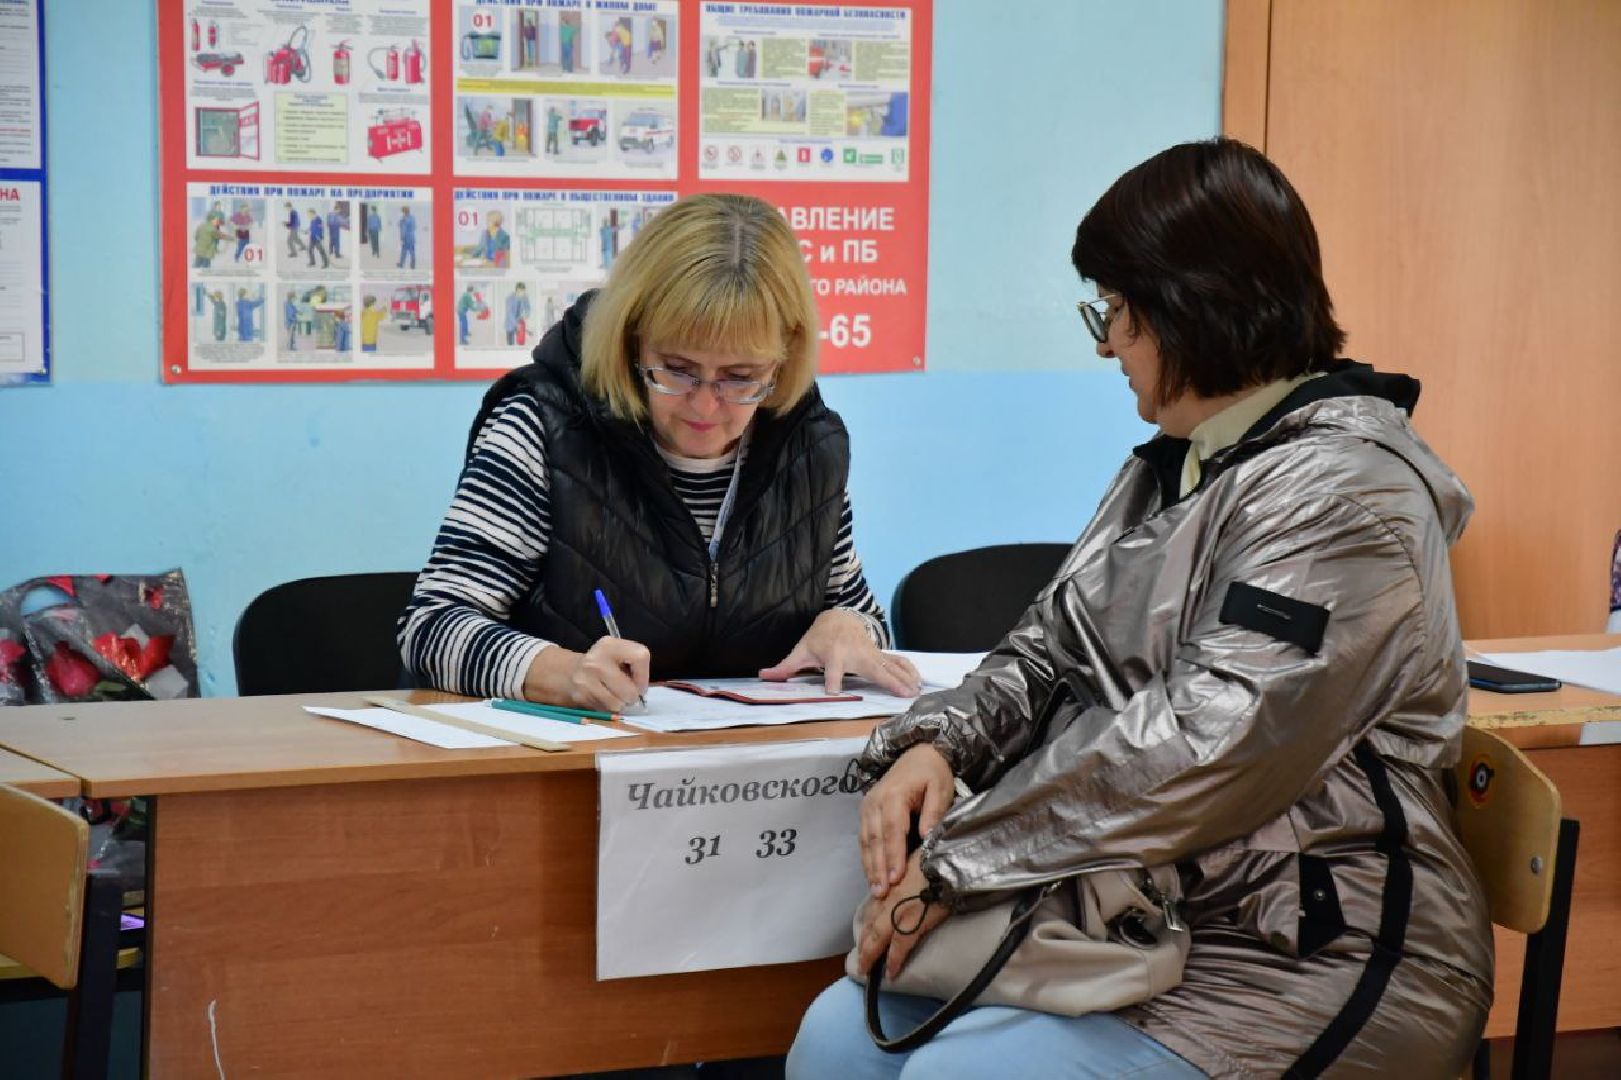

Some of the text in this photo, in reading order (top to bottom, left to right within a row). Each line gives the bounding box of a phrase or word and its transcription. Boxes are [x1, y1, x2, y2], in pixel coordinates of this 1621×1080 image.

[473, 15, 493, 28] 01
[458, 211, 479, 226] 01
[244, 247, 264, 262] 01
[819, 245, 835, 264] и
[842, 239, 879, 264] ПБ
[834, 275, 908, 296] РАЙОНА
[627, 774, 860, 810] Чайковского
[685, 828, 797, 865] 31 33
